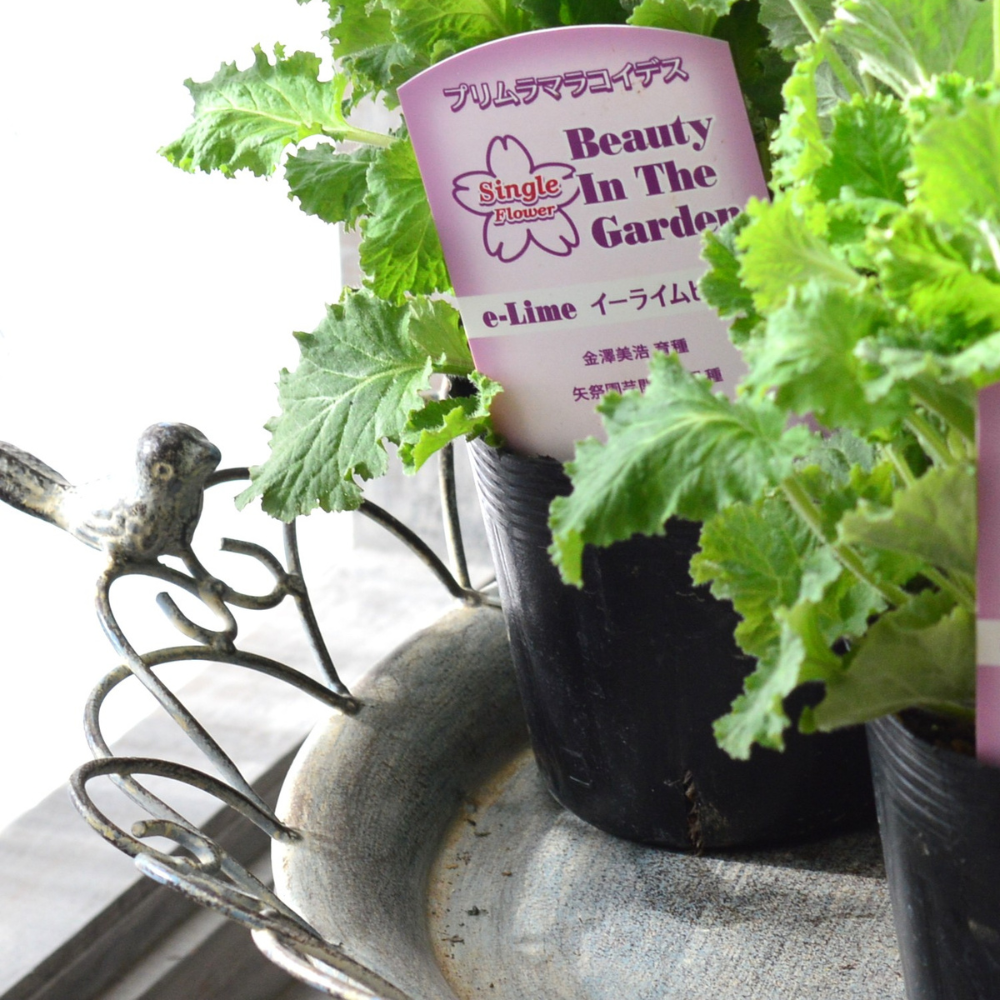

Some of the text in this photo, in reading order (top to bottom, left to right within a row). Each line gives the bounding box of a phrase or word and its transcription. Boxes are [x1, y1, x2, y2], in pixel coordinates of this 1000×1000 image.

[443, 55, 690, 113] プリムラマラコイデス
[563, 113, 713, 162] Beauty
[478, 174, 562, 205] Single
[575, 159, 718, 206] In The
[493, 202, 557, 227] Flower
[482, 299, 578, 329] e-Lime
